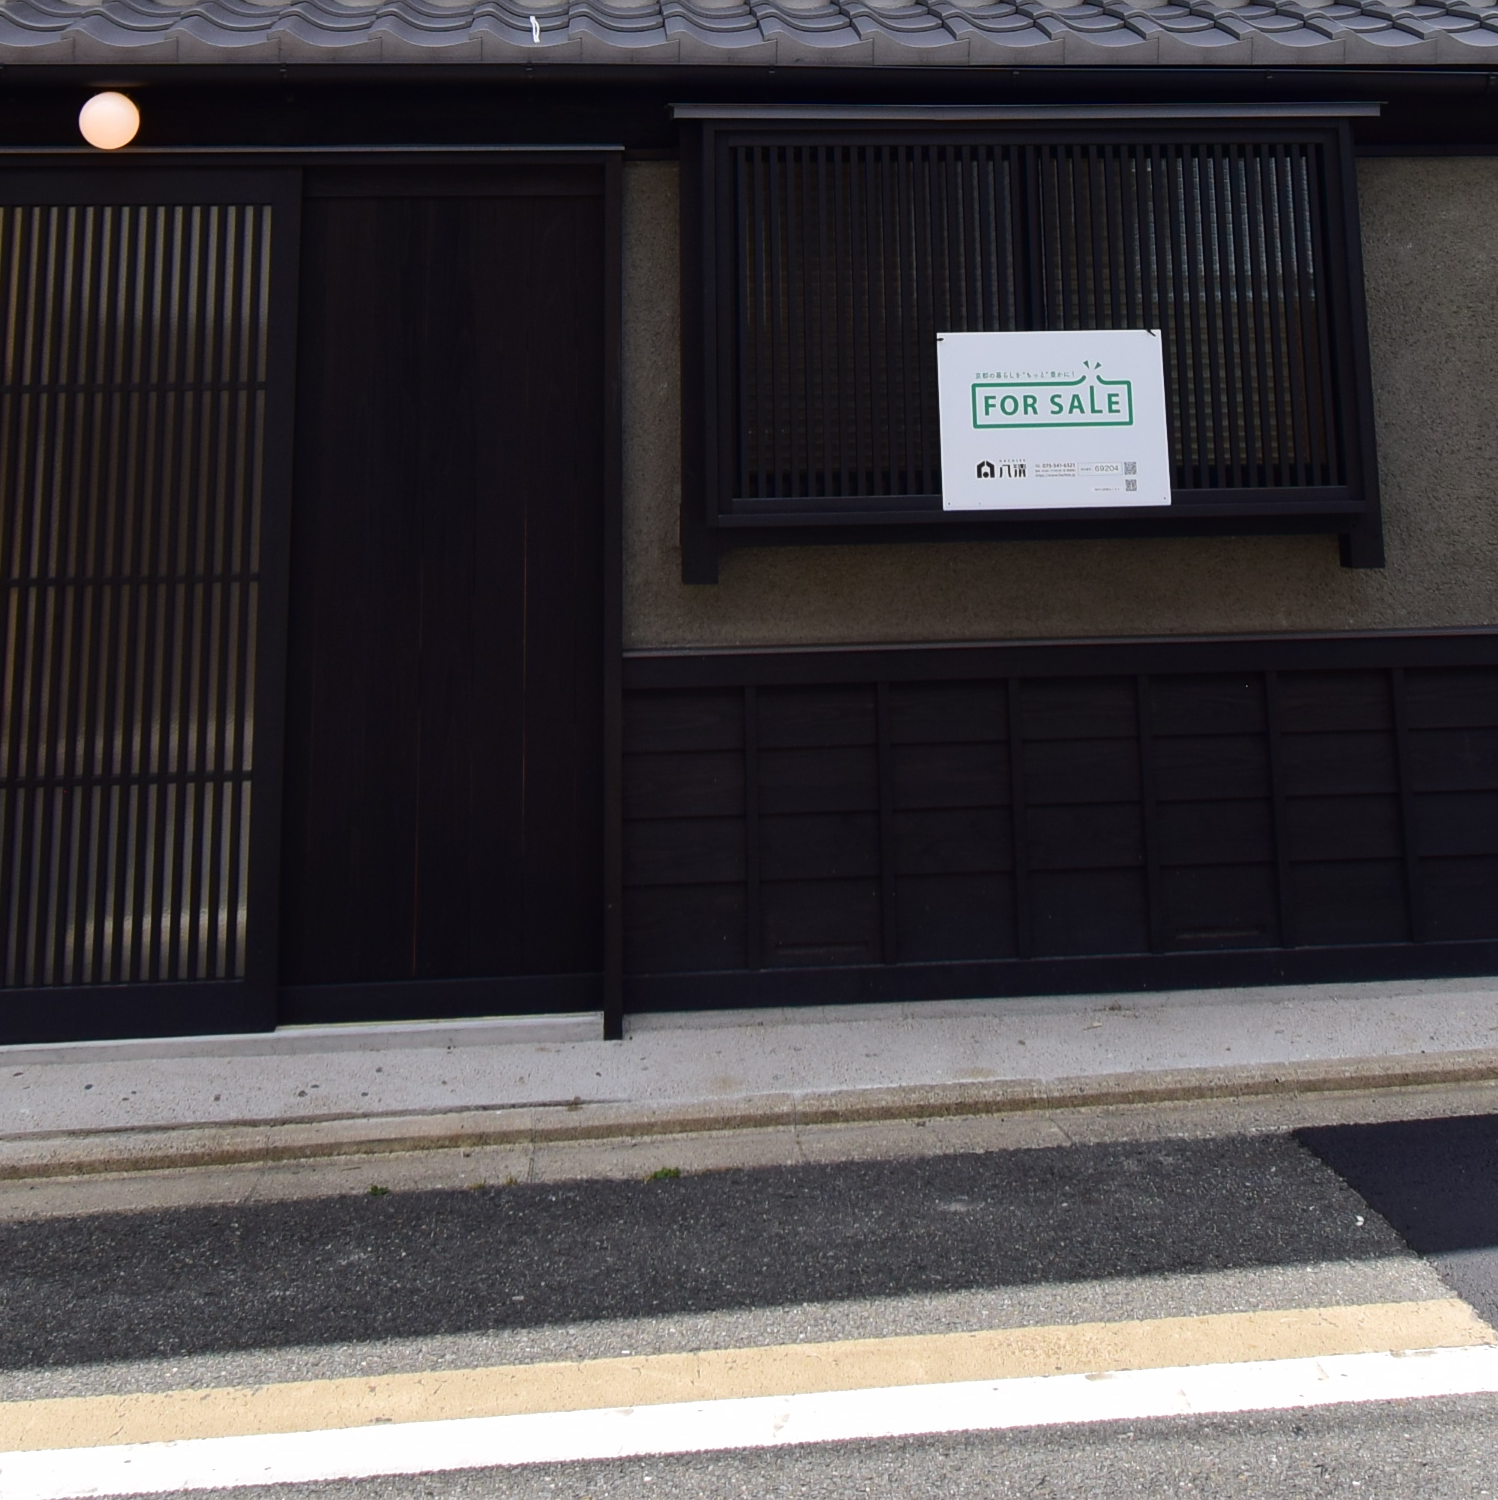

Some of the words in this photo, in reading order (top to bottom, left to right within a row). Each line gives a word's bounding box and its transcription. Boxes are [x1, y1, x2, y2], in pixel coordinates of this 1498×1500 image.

[984, 395, 1038, 416] FOR
[1050, 386, 1121, 415] SALE
[1094, 464, 1119, 472] 69204
